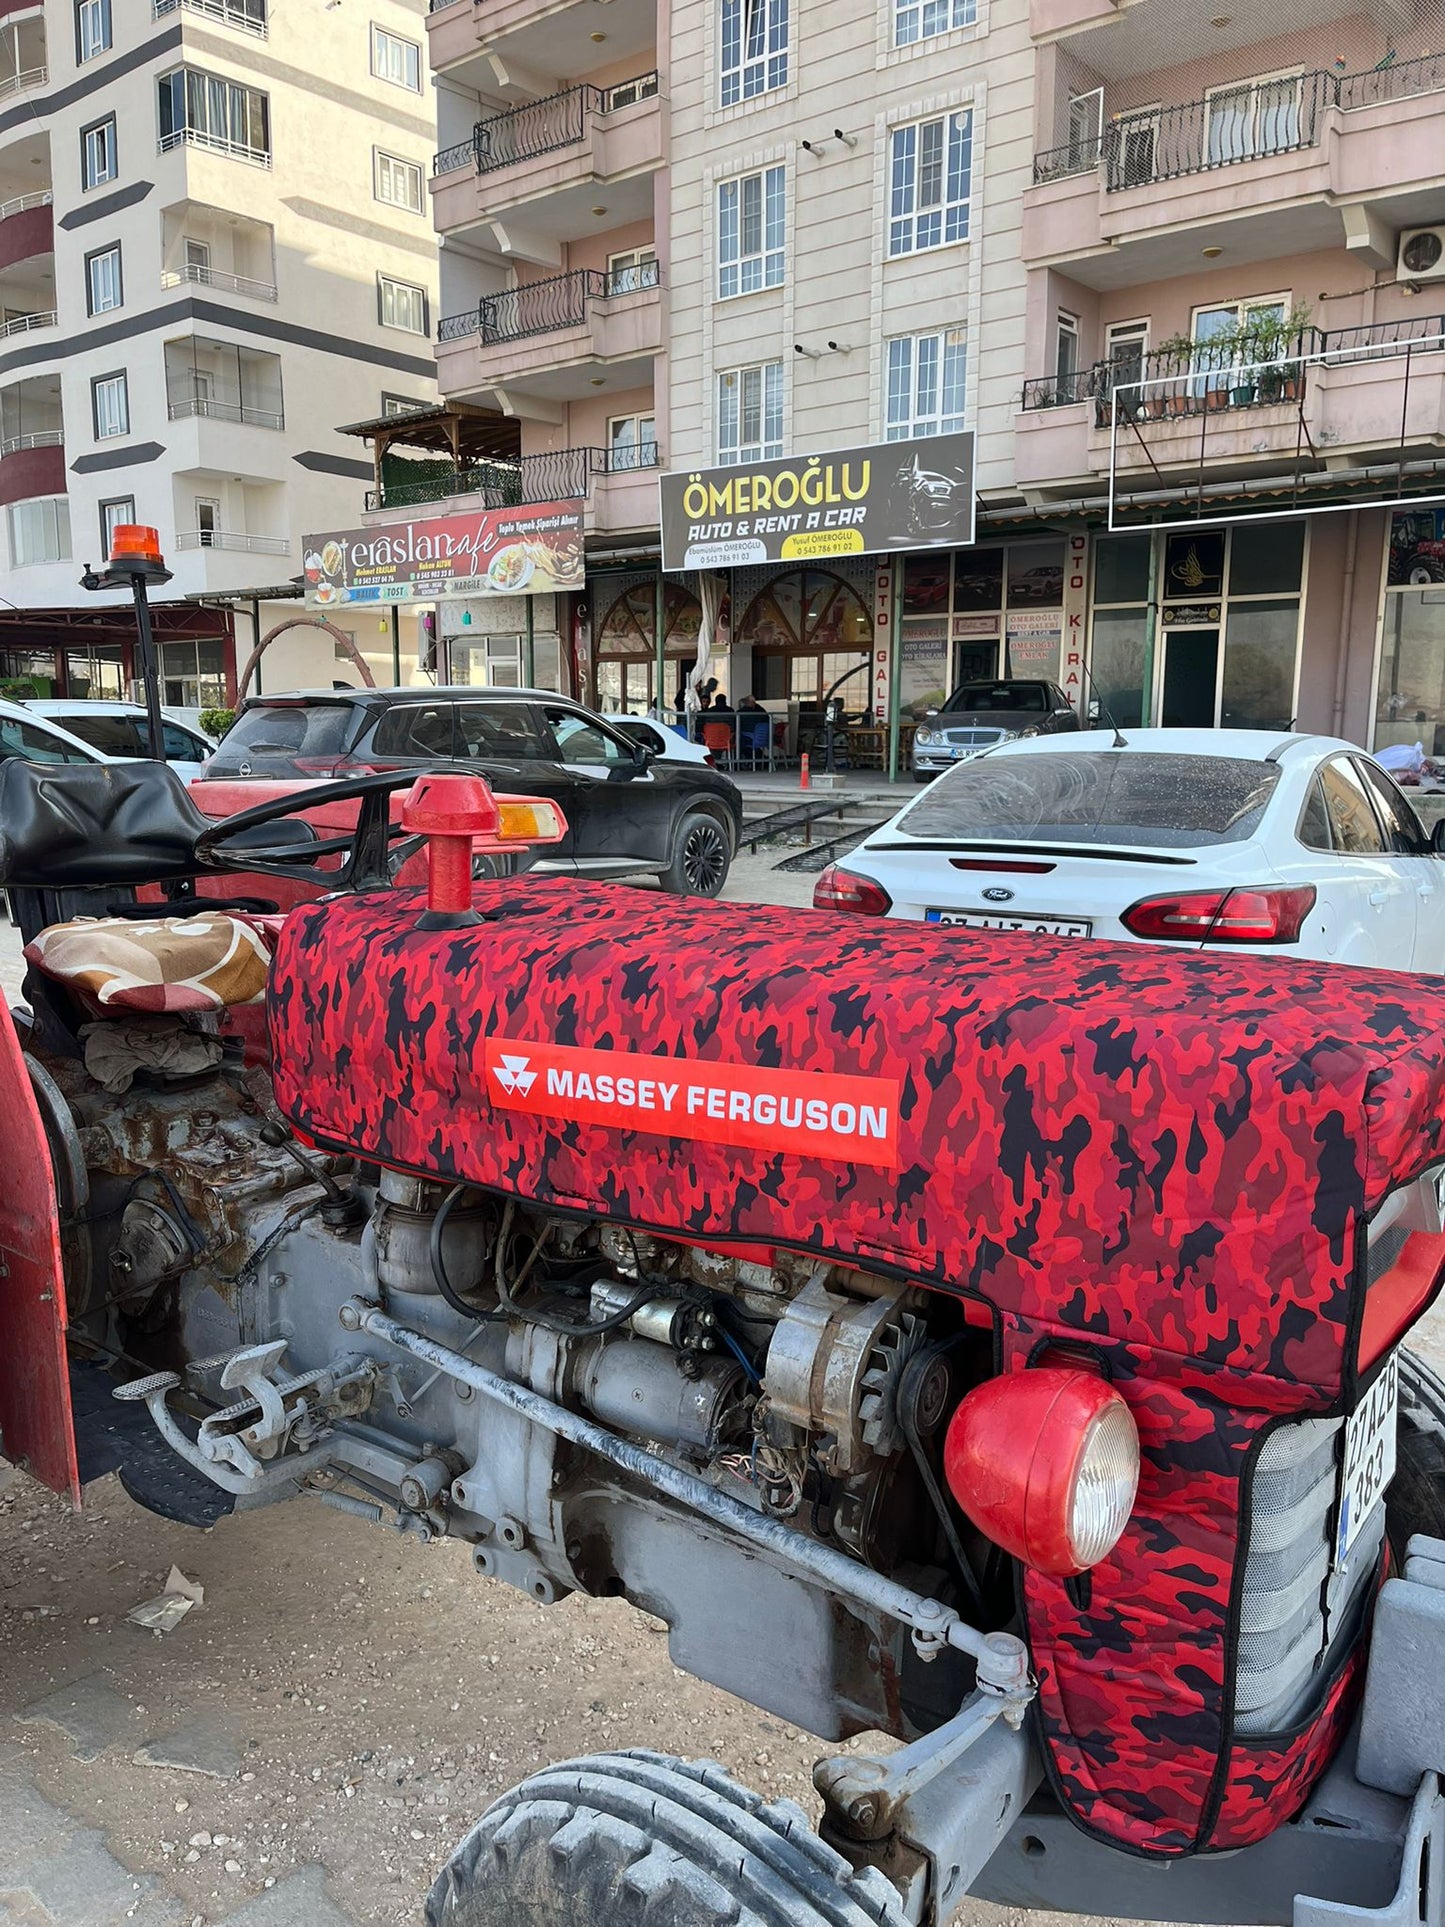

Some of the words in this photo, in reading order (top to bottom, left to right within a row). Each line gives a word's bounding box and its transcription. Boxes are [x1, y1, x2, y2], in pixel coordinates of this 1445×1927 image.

[682, 457, 870, 519] ÖMEROĞLU
[499, 523, 515, 535] Toplu
[516, 520, 535, 531] Yemek
[688, 521, 732, 541] AUTO
[736, 520, 749, 536] &
[754, 513, 802, 534] RENT
[806, 511, 820, 529] A
[823, 506, 867, 526] CAR
[724, 539, 761, 552] ÖMEROĞLU
[792, 535, 810, 545] Yusuf
[811, 531, 853, 544] ÖMEROĞLU
[803, 547, 817, 555] 543
[817, 545, 831, 553] 786
[832, 544, 842, 552] 91
[843, 542, 853, 551] 02
[706, 555, 719, 563] 543
[719, 554, 731, 562] 786
[731, 553, 740, 561] 91
[1070, 536, 1085, 589] OTO
[387, 587, 404, 597] TOST
[453, 579, 481, 591] NARGİLE
[877, 576, 889, 626] OTO
[546, 1068, 680, 1112] MASSEY
[686, 1086, 888, 1139] FERGUSON
[1354, 1438, 1385, 1525] 383
